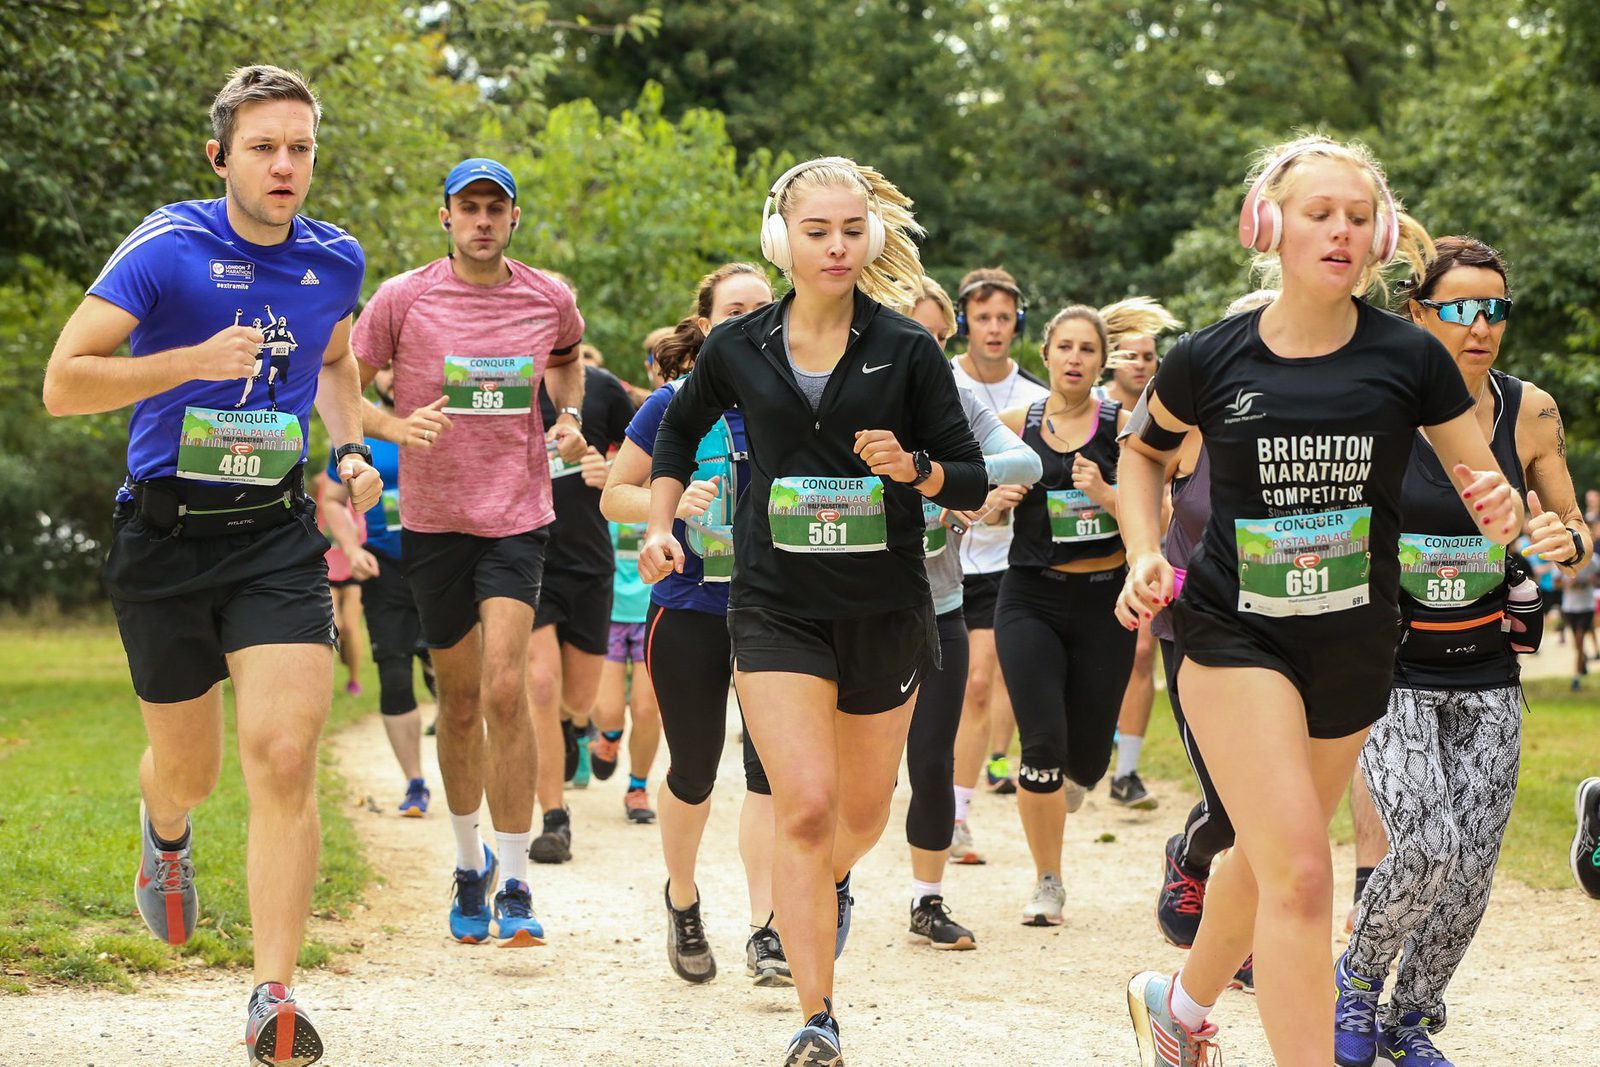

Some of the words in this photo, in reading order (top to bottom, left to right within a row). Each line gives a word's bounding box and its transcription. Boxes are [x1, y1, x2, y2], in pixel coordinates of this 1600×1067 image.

[470, 359, 516, 367] CONQUER
[472, 391, 504, 409] 593
[217, 412, 278, 424] CONQUER
[208, 426, 246, 436] CRYSTAL
[250, 429, 285, 438] PALACE
[1257, 435, 1374, 462] BRIGHTON
[218, 454, 261, 476] 480
[1258, 462, 1372, 484] MARATHON
[802, 479, 863, 491] CONQUER
[793, 495, 832, 503] CRYSTAL
[835, 495, 871, 503] PALACE
[1262, 484, 1364, 507] COMPETITOR
[1268, 507, 1303, 518] SUNDAY
[1076, 518, 1101, 536] 671
[1274, 513, 1344, 532] CONQUER
[809, 522, 847, 545] 561
[1265, 536, 1311, 549] CRYSTAL
[1314, 530, 1351, 544] PALACE
[1425, 537, 1482, 548] CONQUER
[1299, 545, 1329, 553] MARATHON
[1415, 552, 1452, 560] CRYSTAL
[1455, 552, 1488, 560] PALACE
[1286, 566, 1329, 596] 691
[1426, 579, 1466, 601] 538
[1352, 596, 1364, 606] 691
